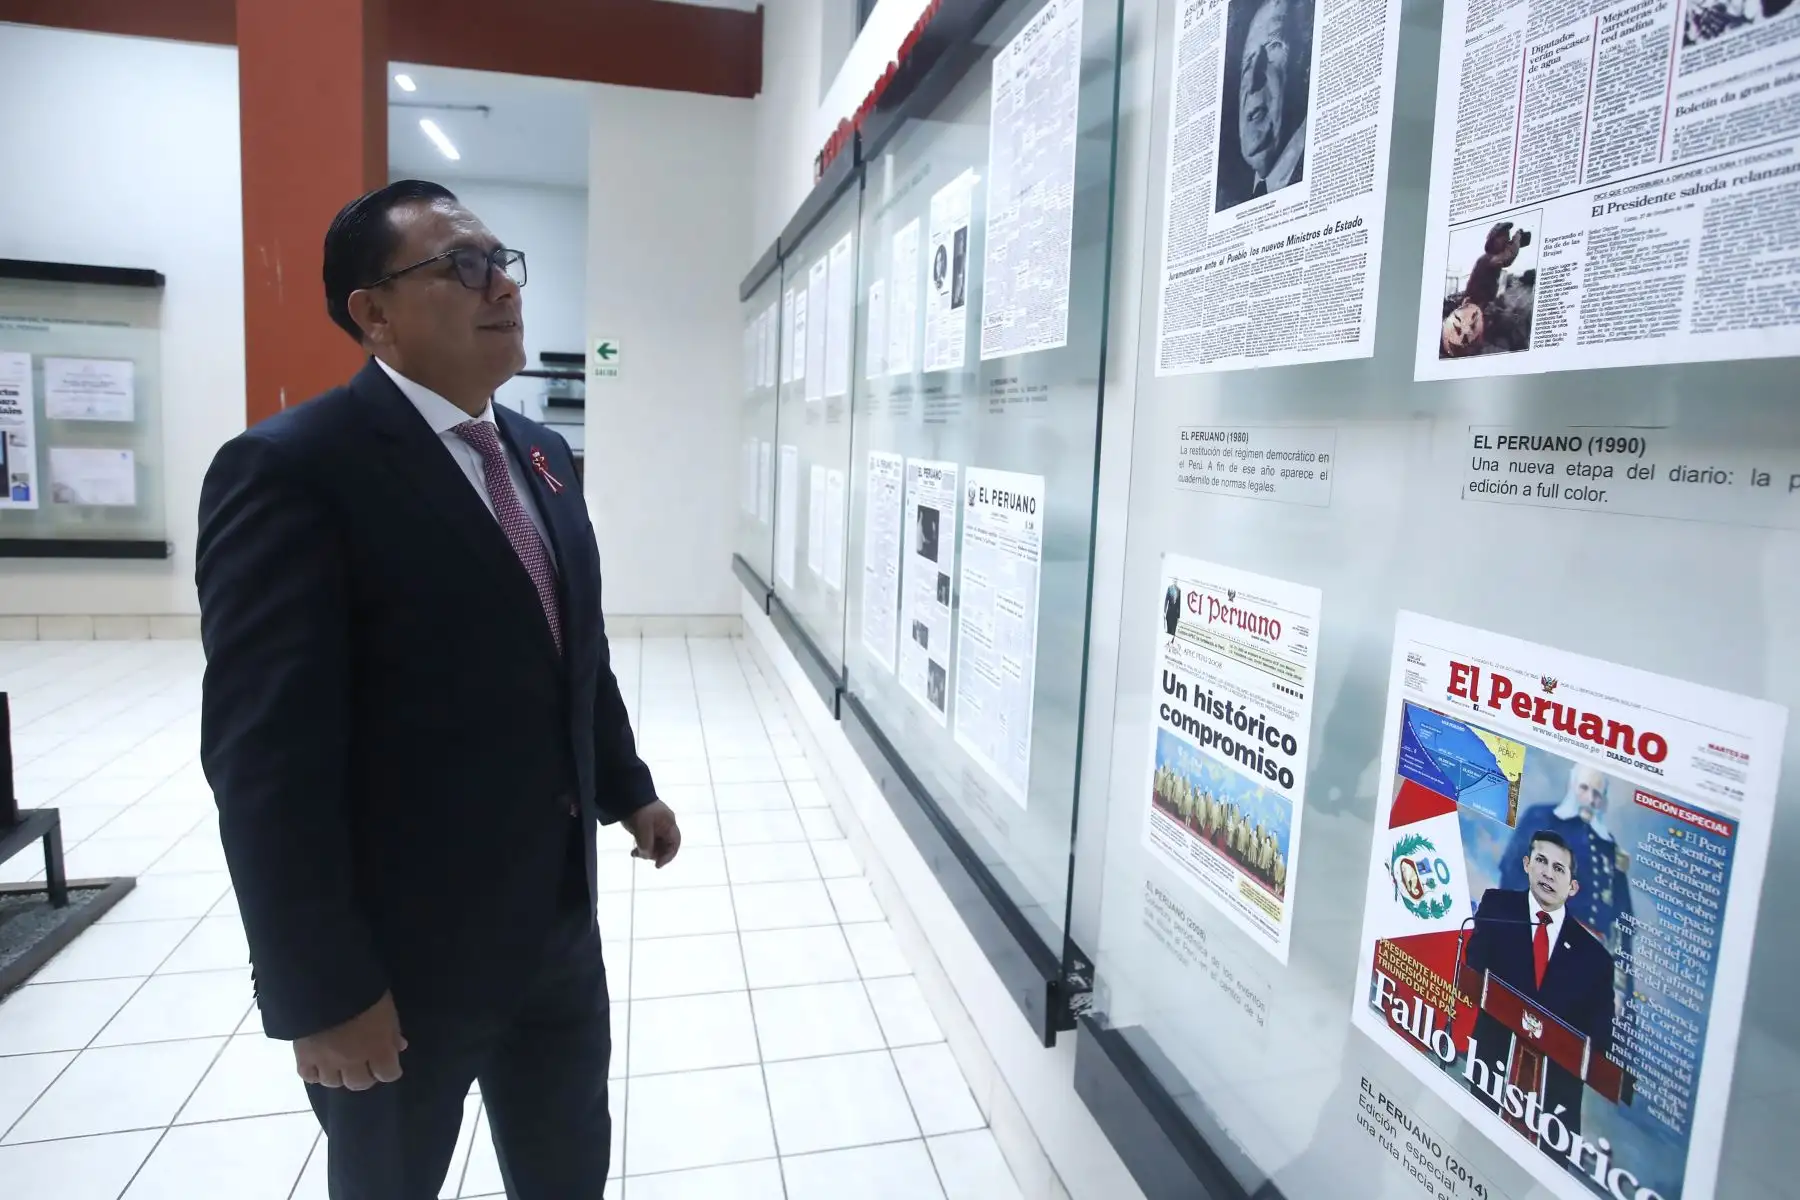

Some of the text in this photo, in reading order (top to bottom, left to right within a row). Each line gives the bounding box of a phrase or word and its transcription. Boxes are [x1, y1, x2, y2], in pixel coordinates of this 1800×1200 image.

[1601, 10, 1652, 34] carreteras
[1601, 18, 1654, 45] red andina
[1530, 34, 1590, 64] verán escasez
[1531, 32, 1575, 56] Diputados
[1528, 56, 1562, 74] de agua
[1590, 206, 1604, 218] El
[1607, 190, 1676, 214] Presidente
[1680, 178, 1727, 198] saluda
[1226, 250, 1248, 264] Pueblo
[1250, 246, 1260, 257] los
[1261, 242, 1284, 254] nuevos
[1286, 229, 1320, 246] Ministros
[1323, 224, 1332, 236] de
[1334, 216, 1363, 233] Estado
[1180, 446, 1330, 463] La restitución del régimen democrático en
[1181, 431, 1249, 444] EL PERUANO (1980)
[1474, 435, 1646, 458] EL PERUANO (1990)
[1178, 460, 1328, 481] el A fin de ese año aparece el
[1212, 476, 1220, 486] de
[1220, 479, 1246, 490] normas
[1471, 456, 1500, 472] Una
[1508, 460, 1555, 476] nueva
[1566, 461, 1614, 481] etapa
[1626, 462, 1656, 481] del
[1668, 464, 1734, 486] diario:
[1750, 467, 1771, 488] la
[979, 486, 1036, 515] EL PERUANO
[1469, 479, 1608, 503] edición a full color.
[1187, 590, 1204, 616] El
[1206, 595, 1282, 641] Peruano
[1162, 669, 1188, 702] Un
[1194, 684, 1298, 757] histórico
[1447, 660, 1480, 702] El
[1488, 672, 1668, 764] Peruano
[1160, 702, 1294, 790] compromiso
[1532, 725, 1664, 776] www.elperuano.pe DIARIO OFICIAL
[1708, 743, 1739, 758] MARTES
[1636, 792, 1730, 836] EDICIÓN ESPECIAL
[1637, 841, 1723, 884] satisfecho por el
[1647, 832, 1724, 870] puede sentirse
[1684, 832, 1726, 856] El Perú
[1636, 854, 1720, 896] reconocimiento
[1654, 874, 1718, 910] de derechos
[1154, 888, 1186, 922] PERUANO
[1632, 878, 1717, 922] soberanos sobre
[1656, 902, 1714, 936] un espacio
[1620, 911, 1672, 942] superior a
[1222, 966, 1234, 982] los
[1379, 937, 1473, 1008] PRESIDENTE HUMALA:
[1614, 960, 1624, 970] el
[1624, 962, 1644, 980] Jefe
[1644, 976, 1661, 991] del
[1638, 945, 1706, 988] del total de la
[1640, 935, 1709, 976] más del 70%
[1378, 945, 1456, 1008] LA DECISIÓN ES UN
[1378, 954, 1457, 1020] TRIUNFO DE LA PAZ
[1665, 972, 1704, 1002] afirma
[1372, 968, 1456, 1063] Fallo
[1620, 1006, 1696, 1060] La Haya cierra
[1626, 998, 1698, 1047] de la Corte de
[1647, 997, 1700, 1034] Sentencia
[1612, 1016, 1694, 1072] definitivamente
[1612, 1026, 1692, 1086] las fronteras del
[1605, 1050, 1688, 1111] una nueva etapa
[1611, 1042, 1690, 1098] país inaugura
[1632, 1083, 1652, 1101] con
[1356, 1112, 1434, 1194] una ruta hacia
[1358, 1093, 1458, 1198] Edición especial.
[1360, 1076, 1488, 1200] EL PERUANO (2014)
